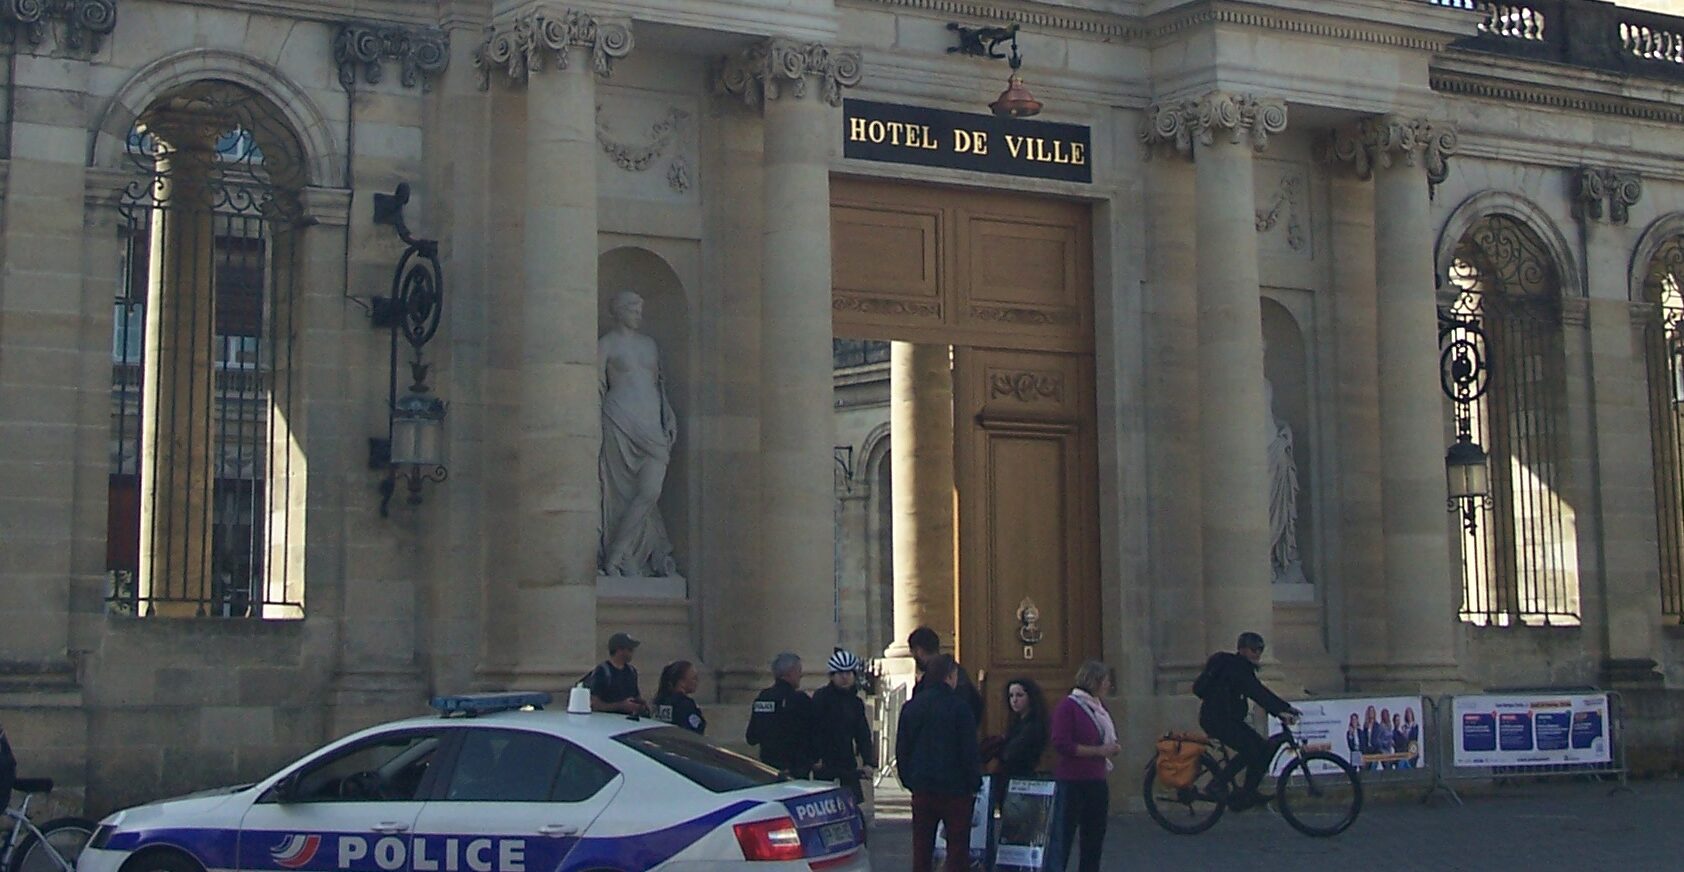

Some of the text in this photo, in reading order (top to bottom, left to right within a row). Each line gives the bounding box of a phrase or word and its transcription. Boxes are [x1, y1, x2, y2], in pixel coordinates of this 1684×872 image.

[850, 117, 1085, 165] HOTEL DE VILLE
[795, 799, 837, 821] POLICE
[338, 836, 526, 872] POLICE
